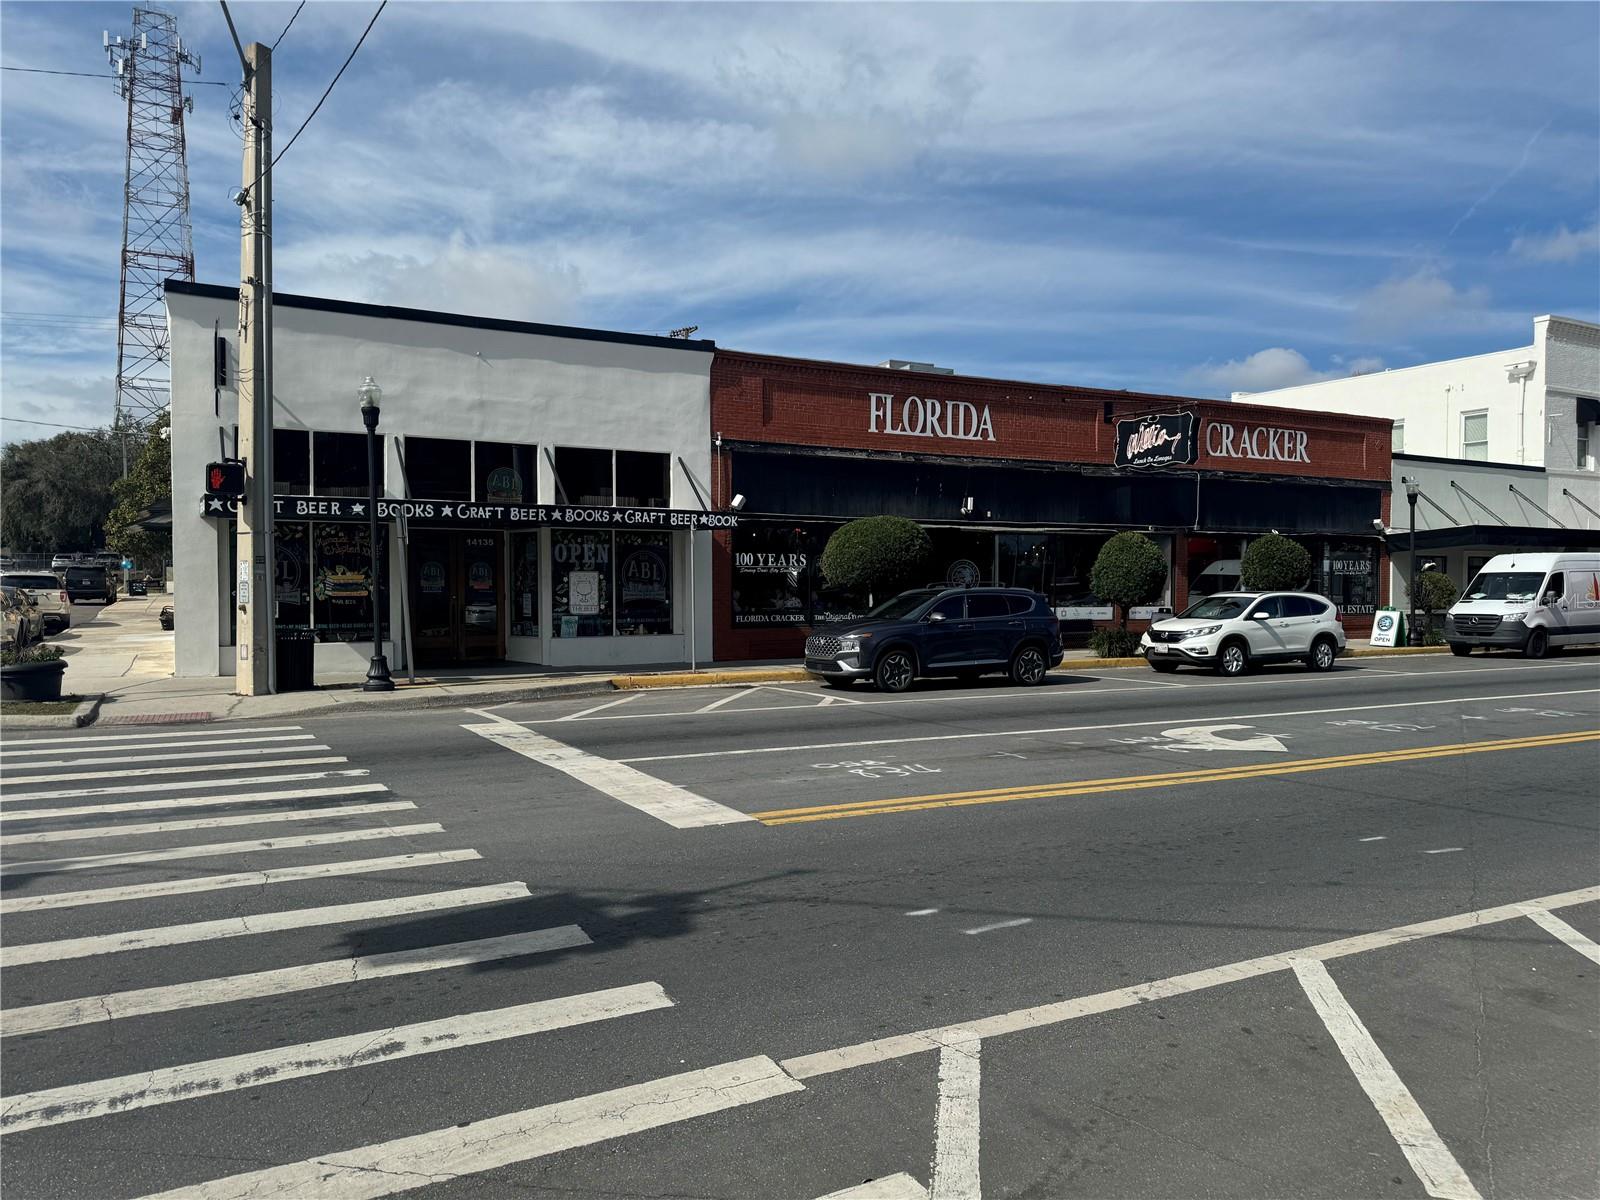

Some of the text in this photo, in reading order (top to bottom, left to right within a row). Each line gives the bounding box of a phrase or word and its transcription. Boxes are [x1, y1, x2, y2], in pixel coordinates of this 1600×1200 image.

[868, 392, 1311, 463] FLORIDA CRACKER
[296, 500, 342, 516] BEER
[376, 502, 434, 518] BOOKS
[457, 504, 504, 519] CRAFT
[510, 507, 547, 521] BEER
[565, 509, 609, 522] BOOKS
[624, 510, 666, 524] CRAFT
[670, 512, 698, 526] BEER
[554, 543, 610, 563] OPEN
[736, 552, 807, 566] 100 YEARS
[1333, 560, 1370, 570] 100 YEARS
[1348, 604, 1375, 614] ESTATE
[736, 614, 805, 623] FLORIDA CRACKER
